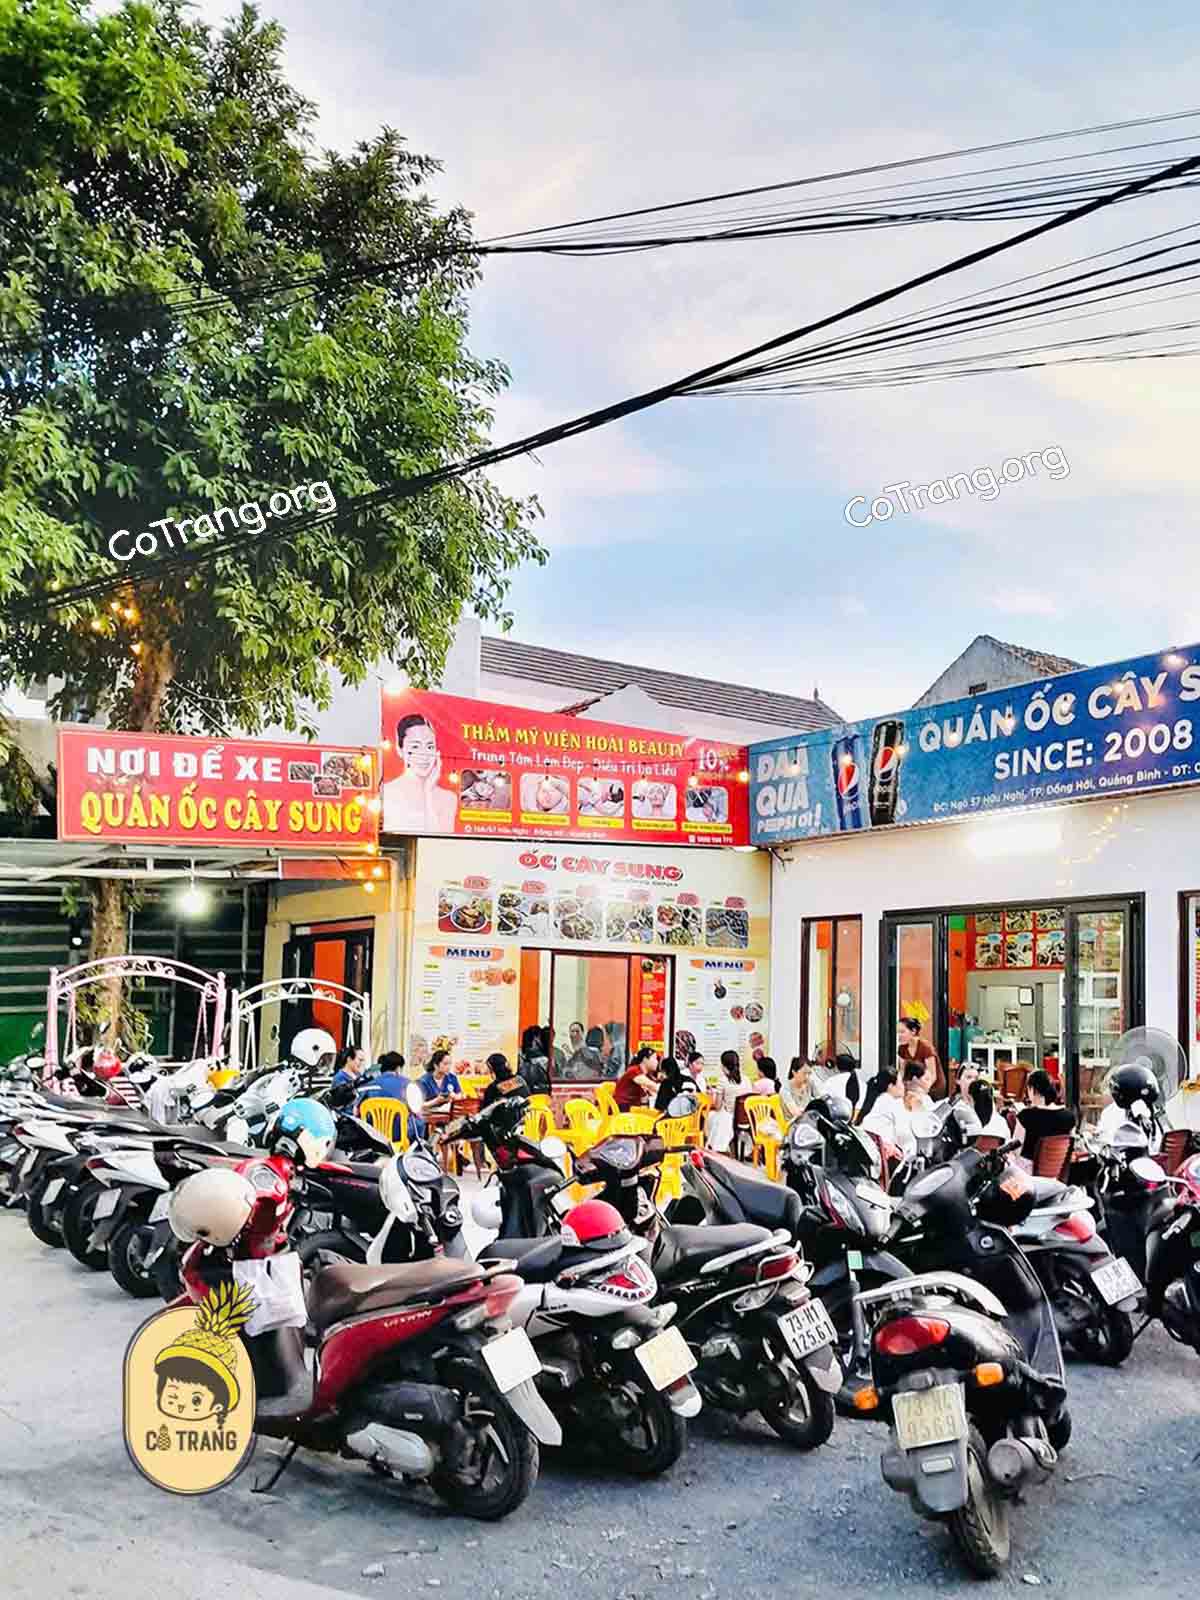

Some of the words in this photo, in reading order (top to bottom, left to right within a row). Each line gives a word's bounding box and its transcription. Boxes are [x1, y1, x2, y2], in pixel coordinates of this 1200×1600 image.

[1024, 684, 1076, 732] ỐC
[1088, 671, 1168, 719] CÂY
[86, 747, 160, 777] NƠI
[235, 755, 283, 783] XE
[628, 738, 684, 757] BEAUTY
[993, 738, 1094, 780] SINCE:
[1103, 720, 1193, 763] 2008
[80, 784, 170, 835] QUÁN
[178, 781, 217, 831] ỐC
[224, 789, 283, 833] CÂY
[288, 801, 362, 834] SUNG
[446, 948, 491, 958] MENU
[704, 960, 743, 969] MENU
